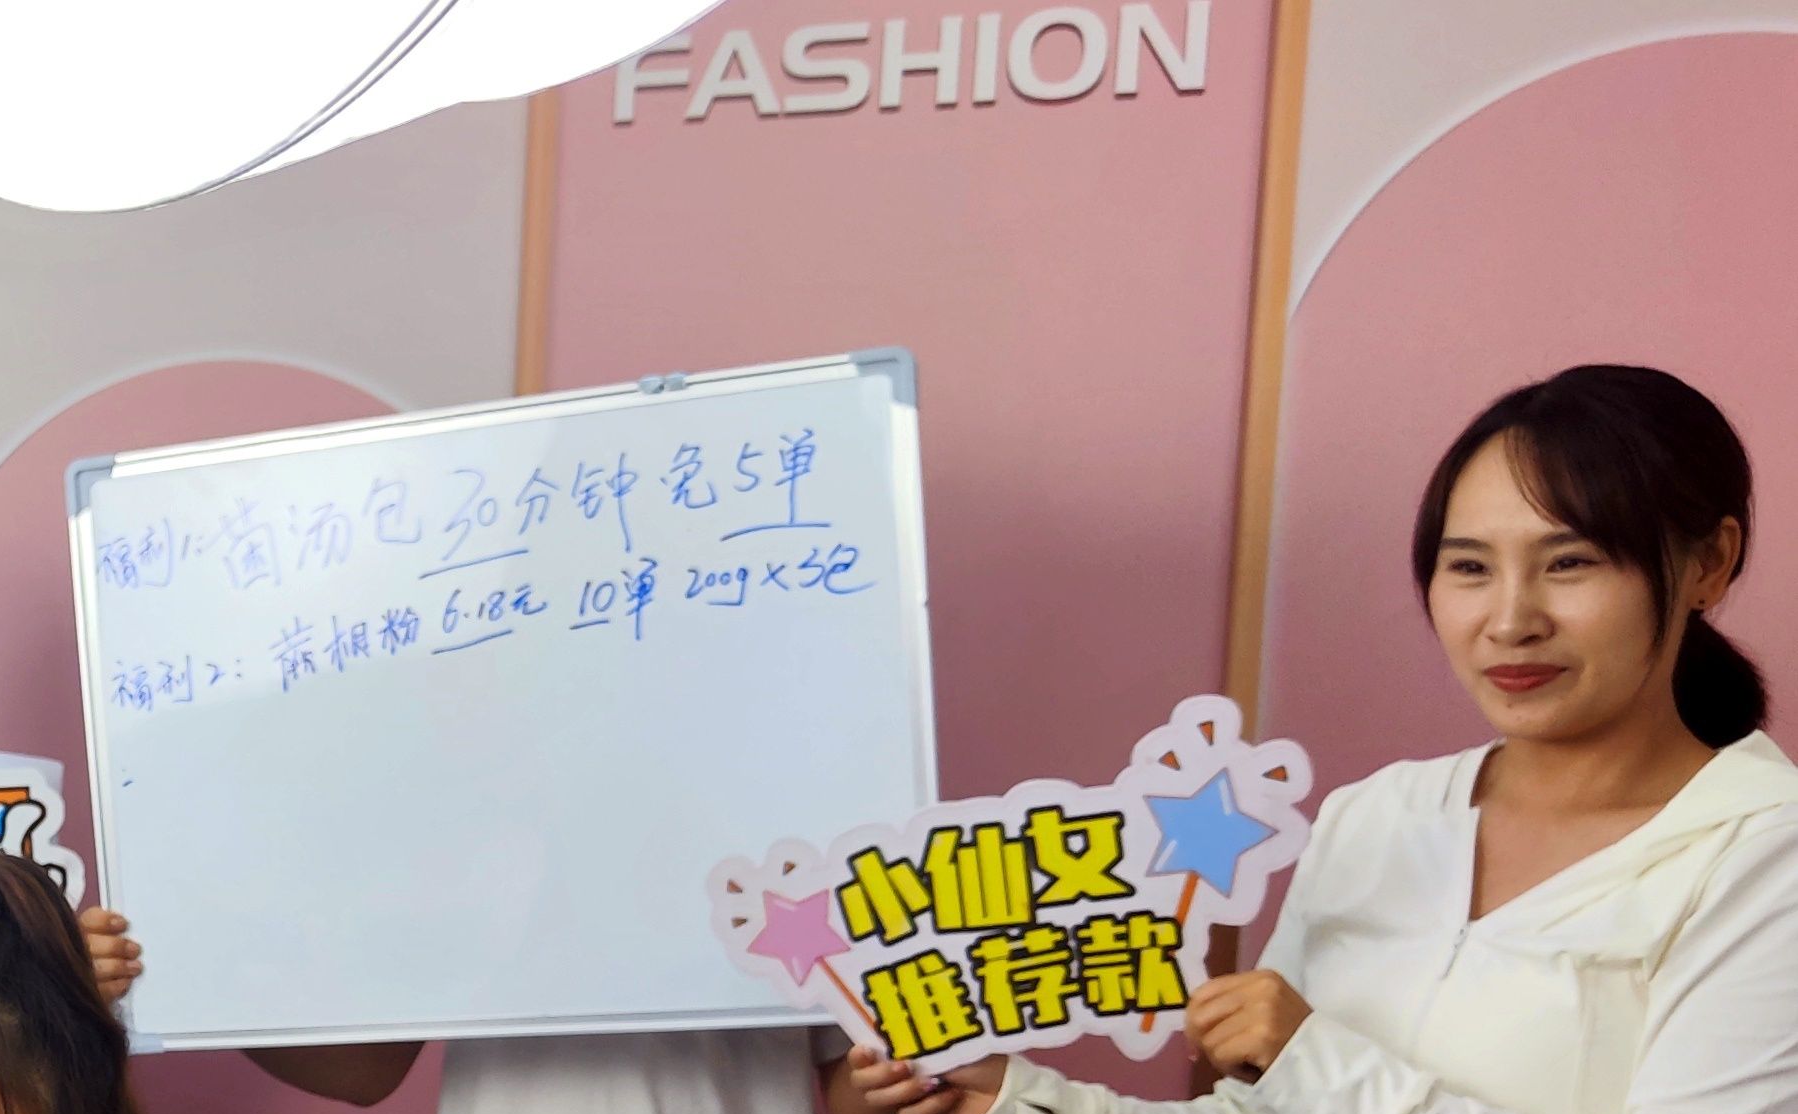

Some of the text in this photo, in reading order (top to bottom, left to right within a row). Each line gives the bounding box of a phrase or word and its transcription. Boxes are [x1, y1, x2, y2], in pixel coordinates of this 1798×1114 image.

[613, 1, 1210, 124] FASHION
[835, 804, 1134, 946] 小仙女
[862, 910, 1190, 1061] 推荐款
